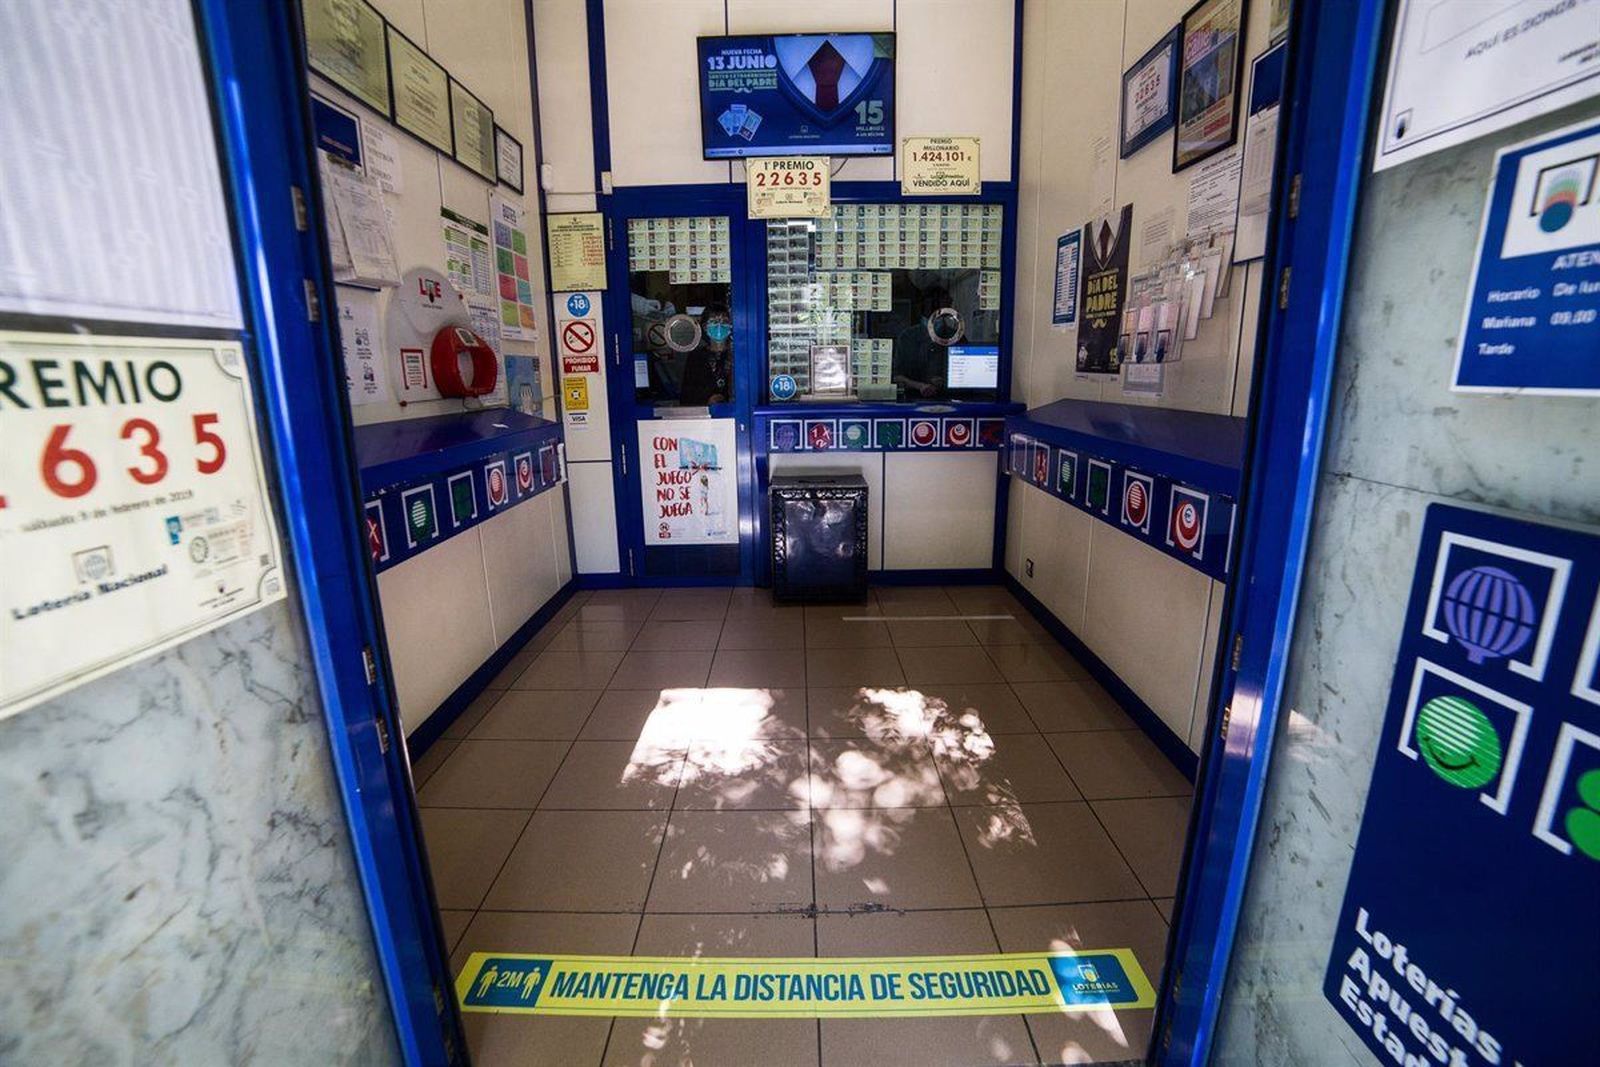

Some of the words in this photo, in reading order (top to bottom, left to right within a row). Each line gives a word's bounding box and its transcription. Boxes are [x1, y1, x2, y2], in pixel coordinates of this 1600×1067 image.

[707, 56, 725, 70] 13
[727, 54, 777, 69] JUNIO
[746, 78, 777, 87] PADRE
[855, 100, 884, 125] 15
[913, 151, 964, 162] 1.424.101
[773, 160, 814, 170] PREMIO
[756, 171, 822, 187] 22635
[1487, 288, 1540, 303] Horario
[1552, 283, 1577, 297] De
[1086, 291, 1118, 313] PADRE
[1478, 343, 1515, 355] Tarde
[653, 437, 677, 451] CON
[655, 453, 666, 469] EL
[656, 470, 692, 486] JUEGO
[657, 487, 675, 502] NO
[679, 486, 690, 500] SE
[659, 502, 692, 519] JUEGA
[98, 563, 168, 594] Nacional
[496, 971, 523, 988] 2M
[550, 971, 689, 1001] MANTENGA
[696, 974, 727, 1001] LA
[734, 973, 865, 1002] DISTANCIA
[871, 973, 905, 1001] DE
[910, 969, 1051, 1000] SEGURIDAD
[1355, 907, 1503, 1065] Loterías
